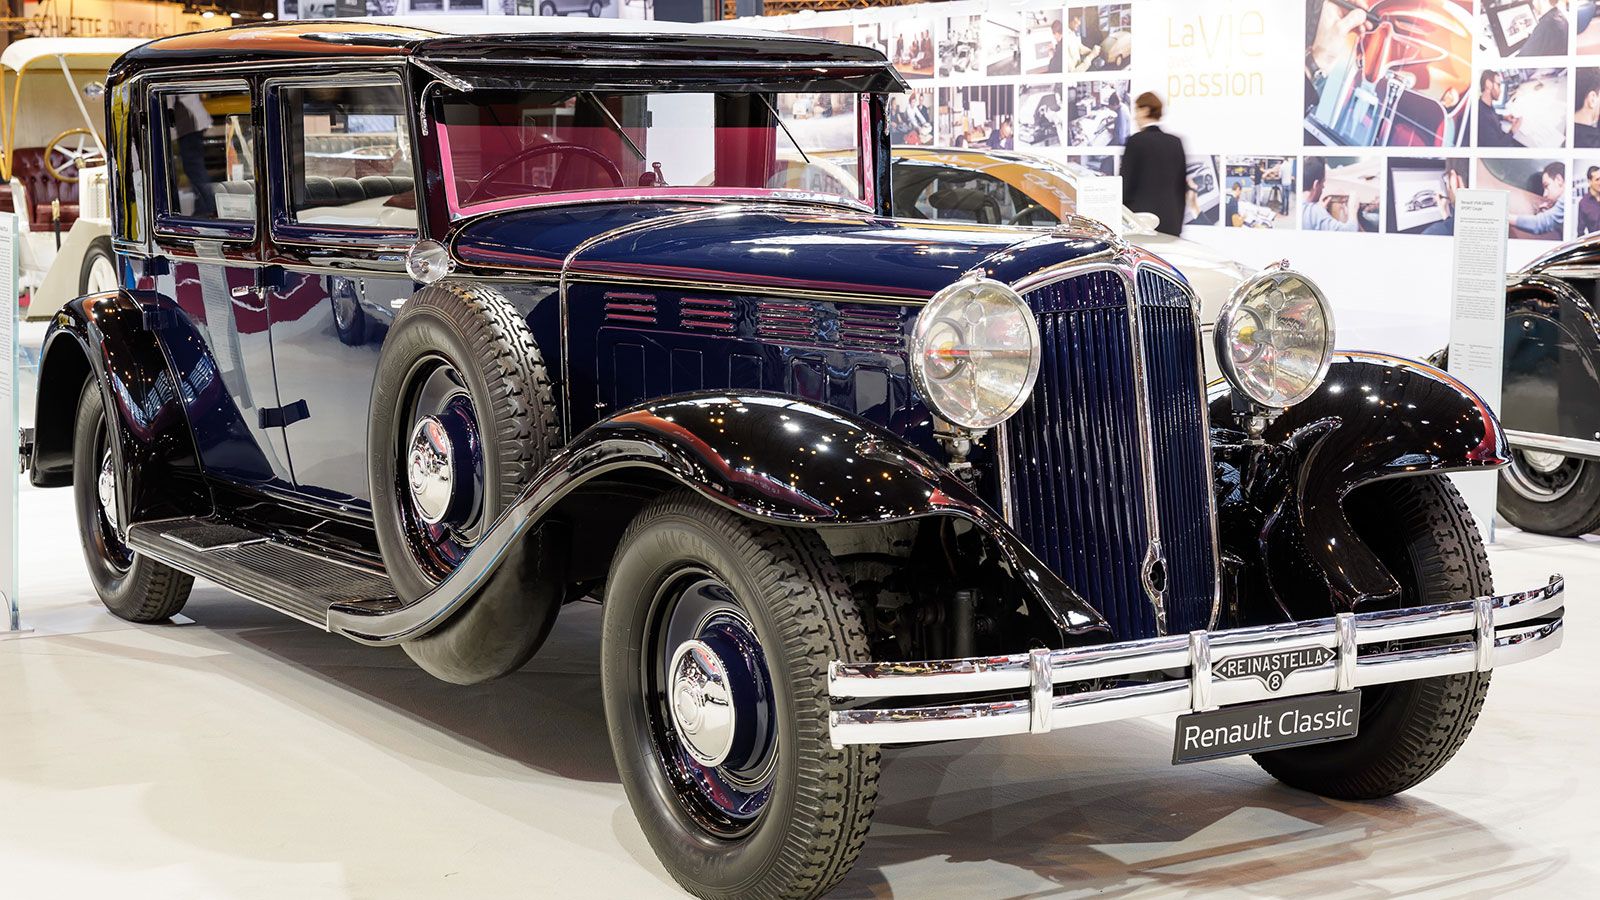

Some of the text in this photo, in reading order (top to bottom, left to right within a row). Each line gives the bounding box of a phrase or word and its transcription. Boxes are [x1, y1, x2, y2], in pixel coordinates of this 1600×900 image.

[1167, 64, 1265, 107] passion
[1227, 650, 1323, 676] REINASTELLA
[1271, 674, 1280, 690] 8
[1184, 704, 1353, 750] Renault Classic
